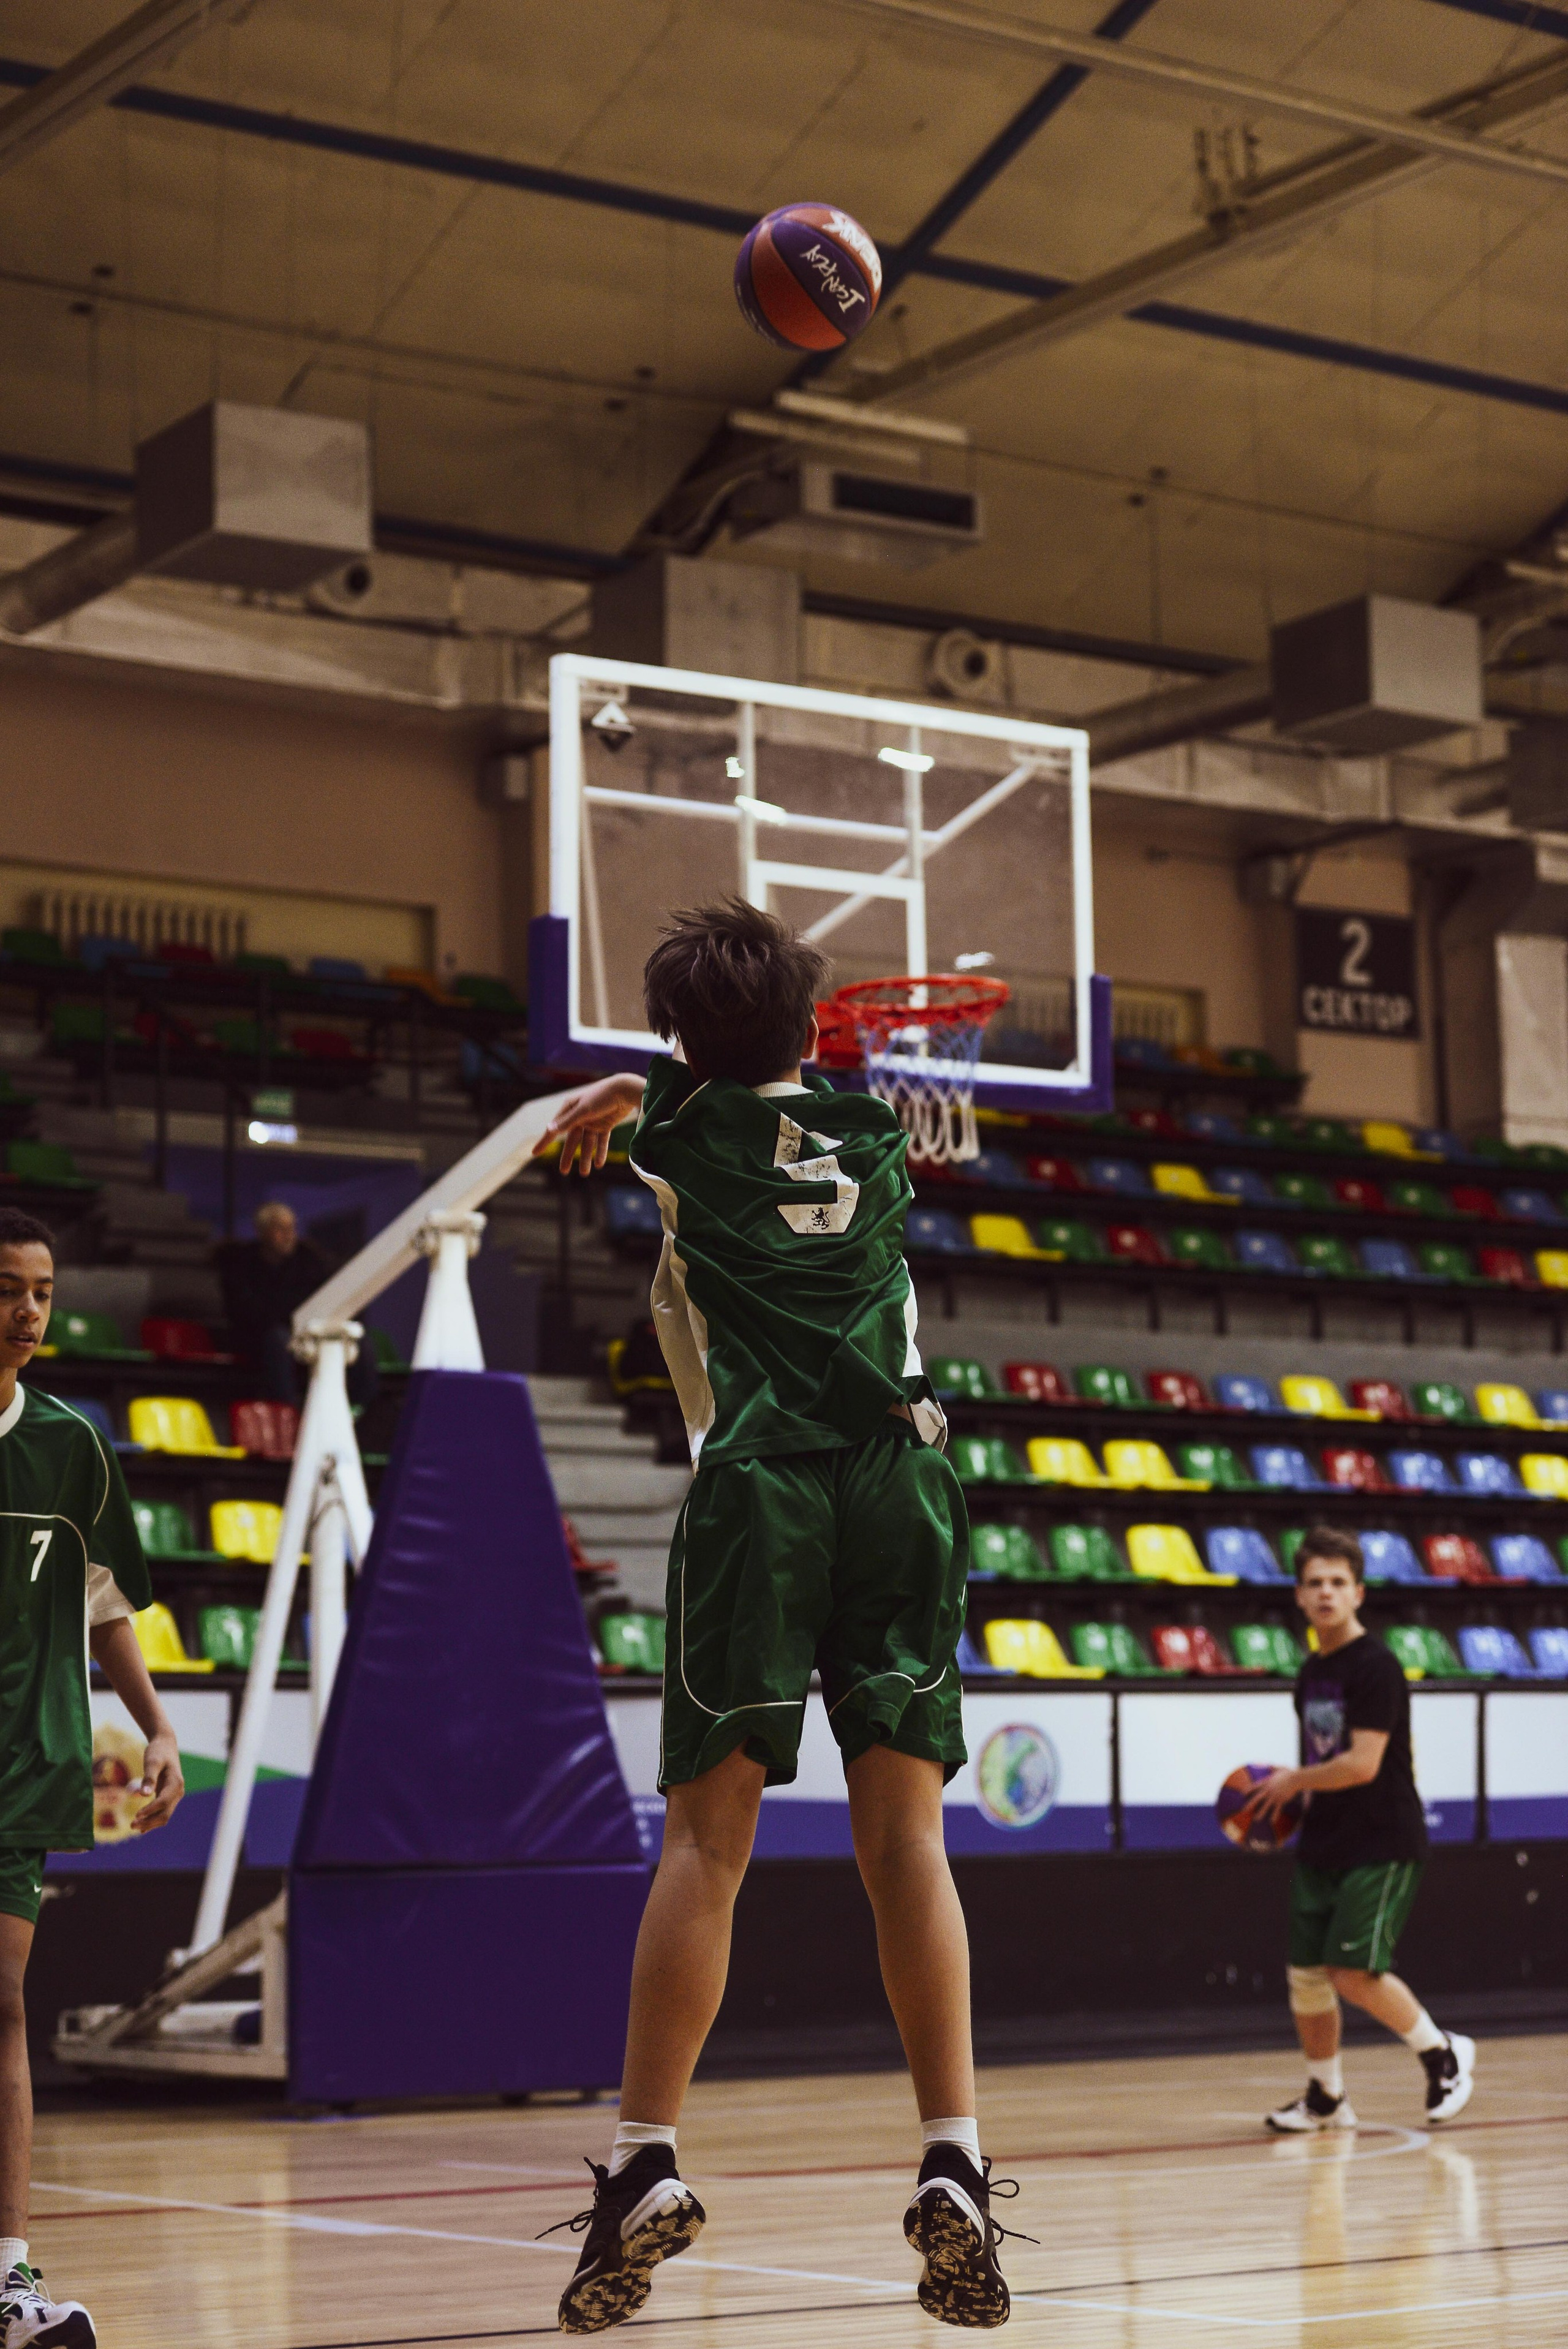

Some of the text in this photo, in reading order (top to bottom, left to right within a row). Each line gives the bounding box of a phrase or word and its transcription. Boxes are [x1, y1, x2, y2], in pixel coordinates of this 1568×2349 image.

[822, 211, 883, 293] PEAK
[1341, 919, 1372, 986] 2
[1303, 986, 1412, 1030] СЕКТОР
[774, 1111, 859, 1234] 5
[30, 1530, 52, 1582] 7
